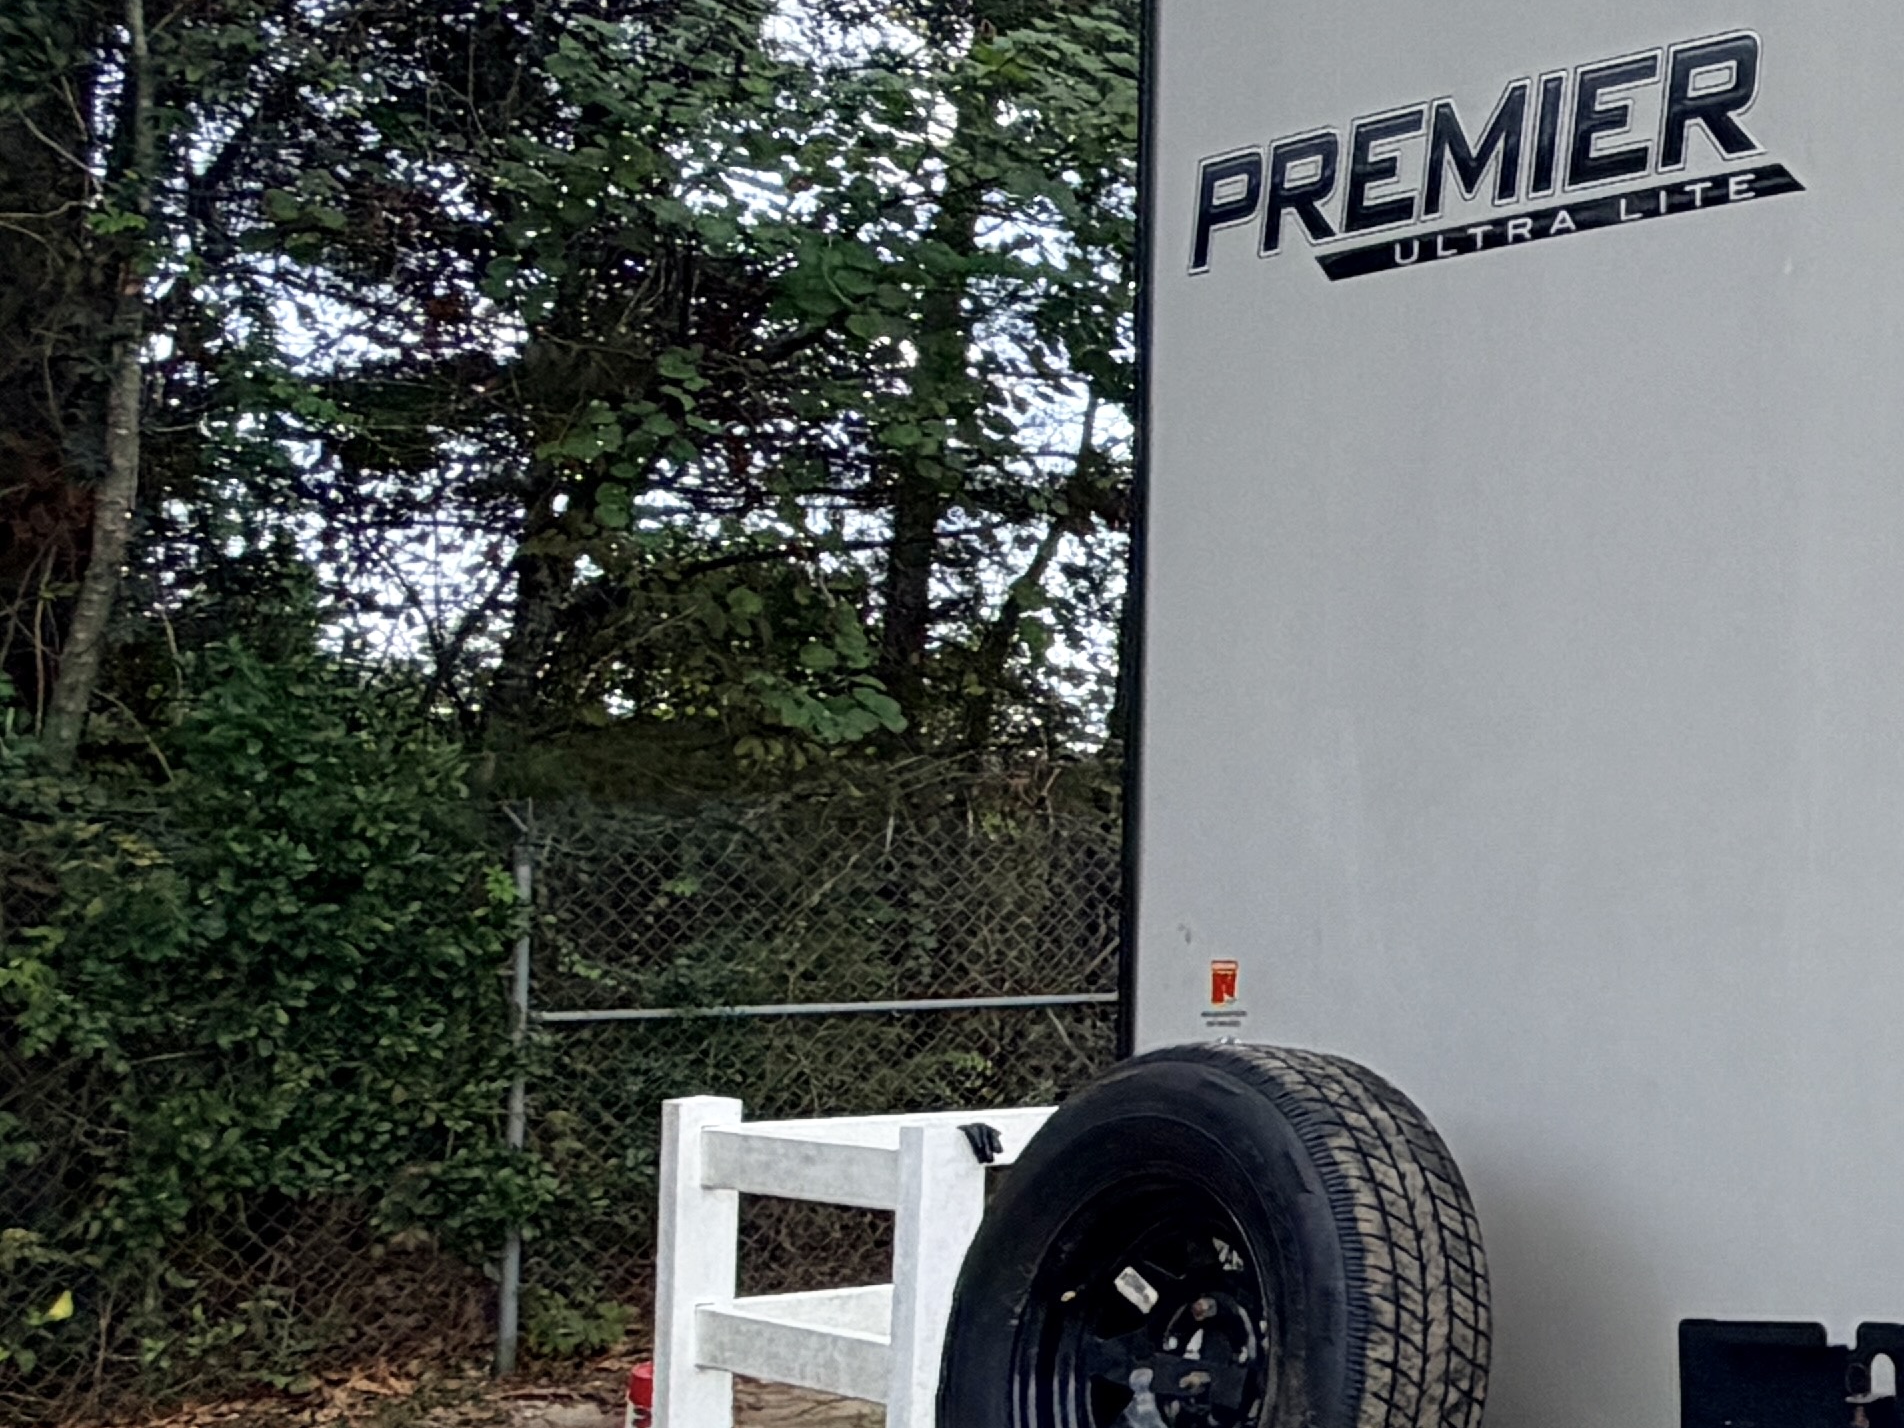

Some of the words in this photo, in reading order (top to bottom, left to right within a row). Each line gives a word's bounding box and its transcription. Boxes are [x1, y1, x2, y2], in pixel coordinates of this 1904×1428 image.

[1188, 28, 1768, 276] PREMIER
[1394, 209, 1577, 265] ULTRA
[1619, 173, 1757, 222] LITE
